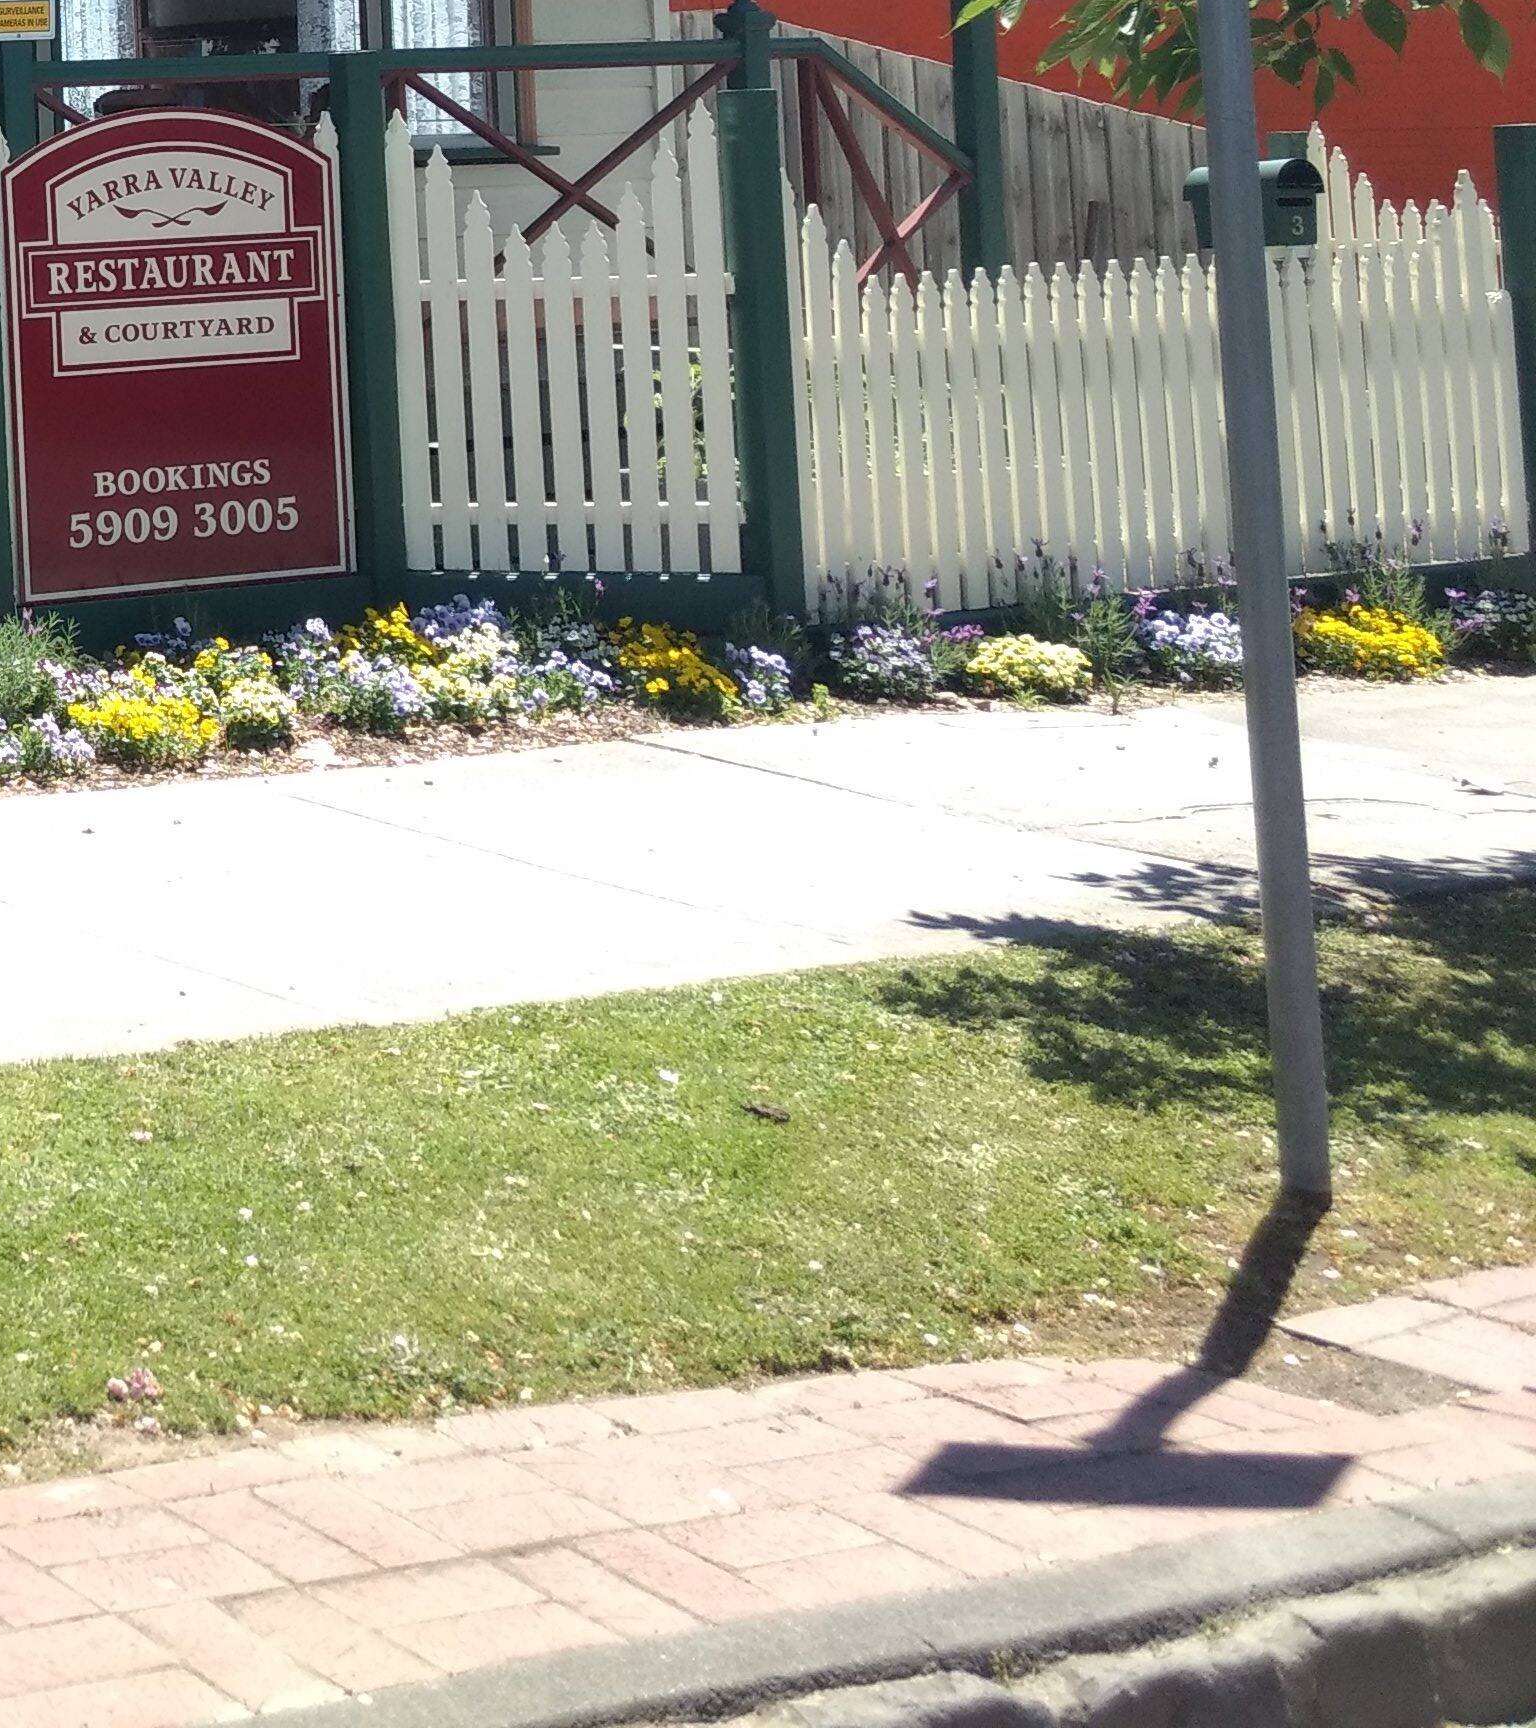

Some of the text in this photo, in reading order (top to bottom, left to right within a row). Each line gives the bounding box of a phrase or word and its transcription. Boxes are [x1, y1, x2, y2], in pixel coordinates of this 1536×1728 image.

[27, 18, 35, 27] IN
[66, 167, 276, 221] YARRA VALLEY
[1292, 216, 1304, 236] 3
[47, 248, 295, 296] RESTAURANT
[78, 315, 276, 345] & COURTYARD
[93, 459, 271, 498] BOOKINGS
[68, 495, 301, 549] 5909 3005
